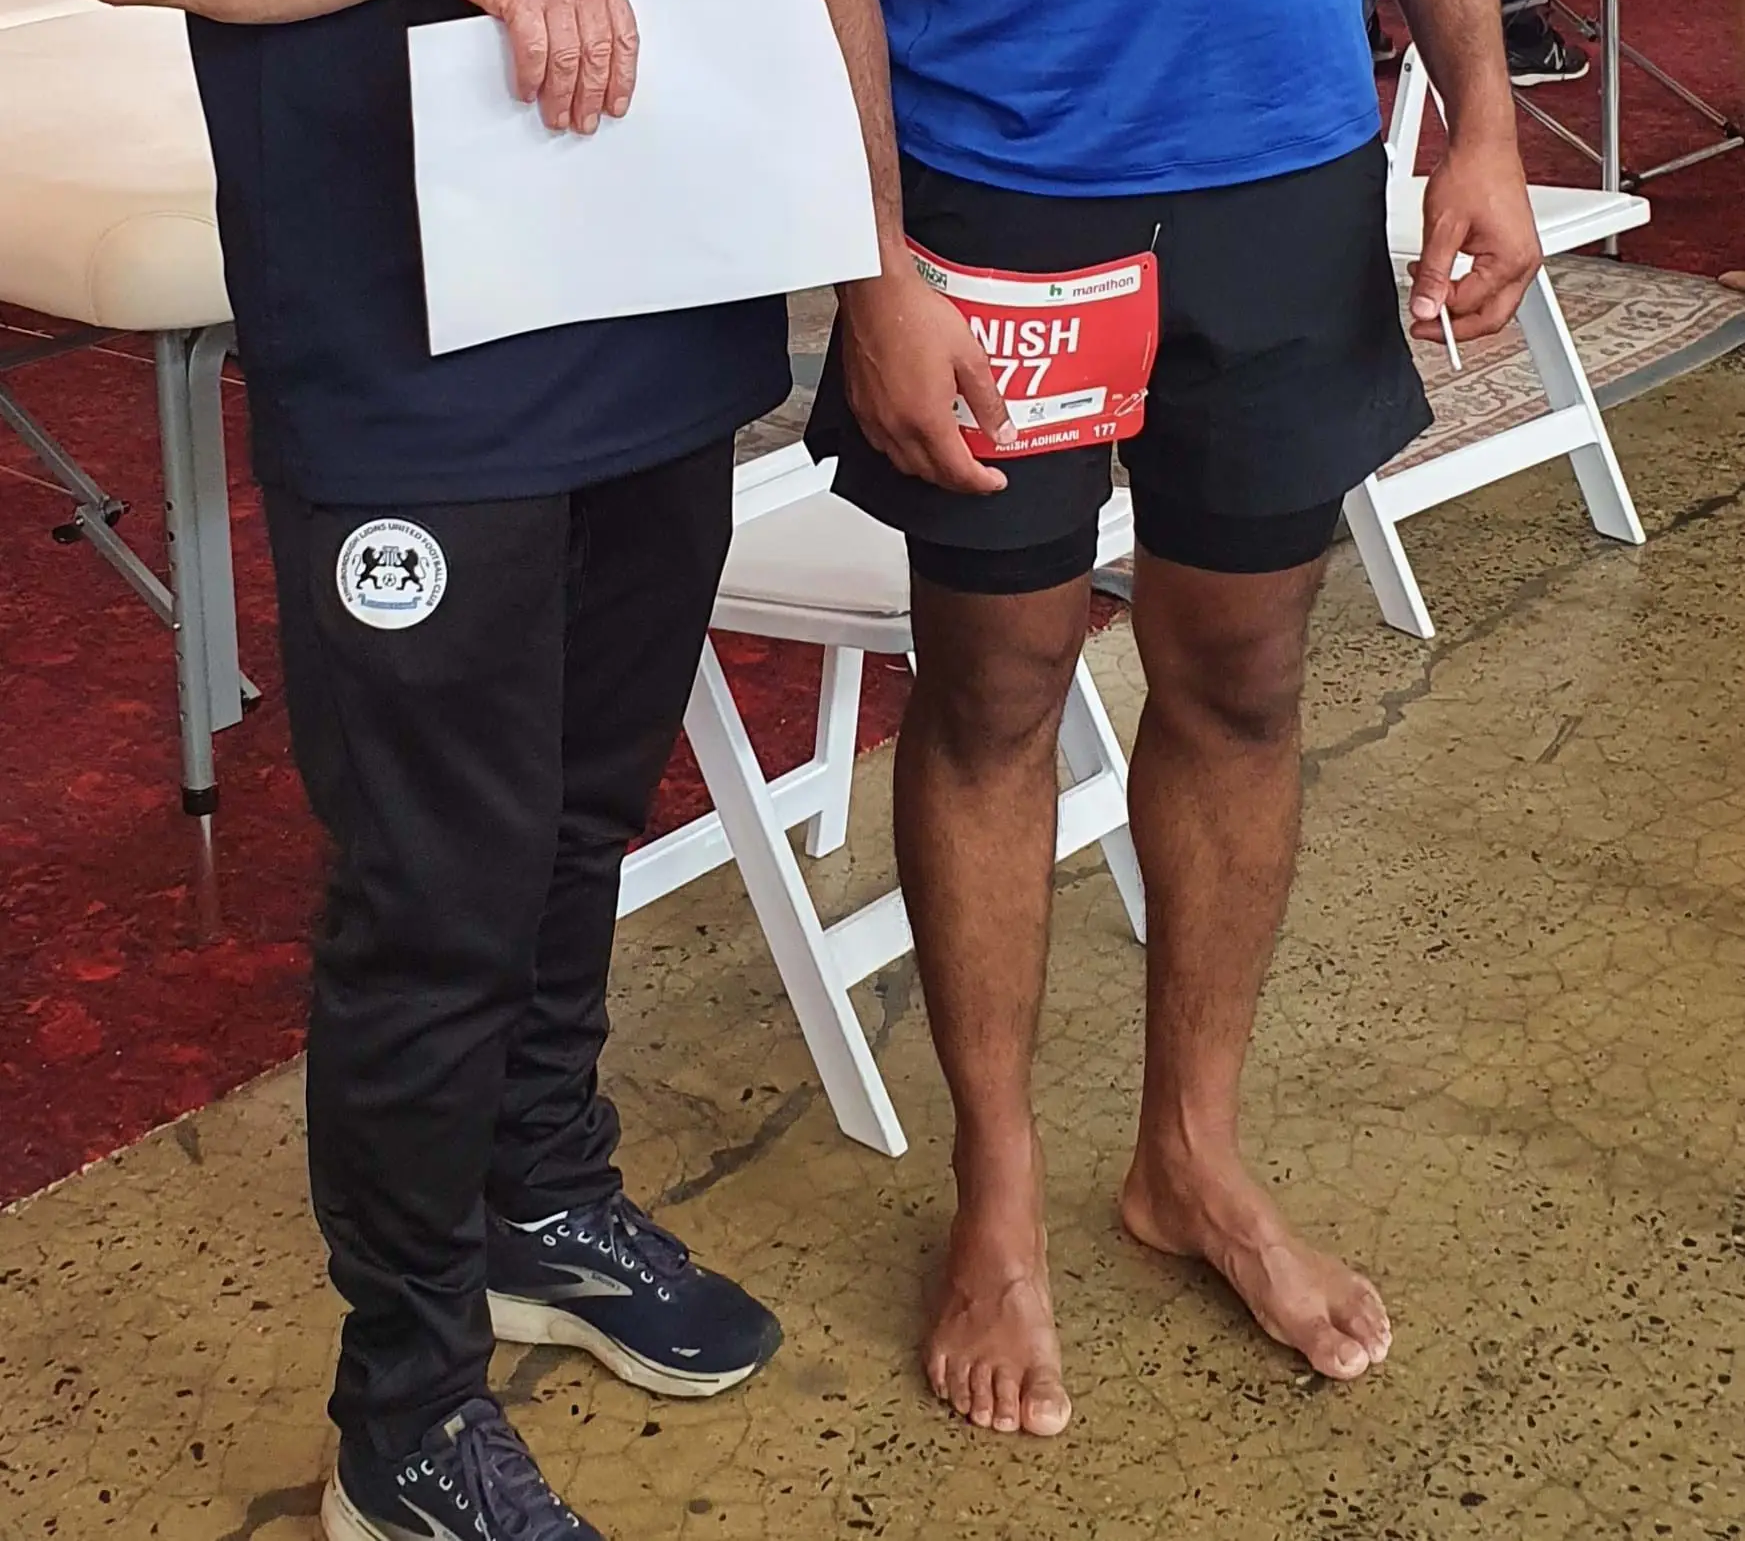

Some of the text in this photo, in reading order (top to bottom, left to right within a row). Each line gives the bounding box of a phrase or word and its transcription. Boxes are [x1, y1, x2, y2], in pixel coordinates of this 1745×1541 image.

[1072, 275, 1134, 297] marathon
[969, 315, 1081, 358] NISH
[989, 357, 1052, 397] 77
[1031, 429, 1080, 448] ADHIKARI
[1093, 422, 1117, 438] 177
[388, 523, 422, 540] UNITED
